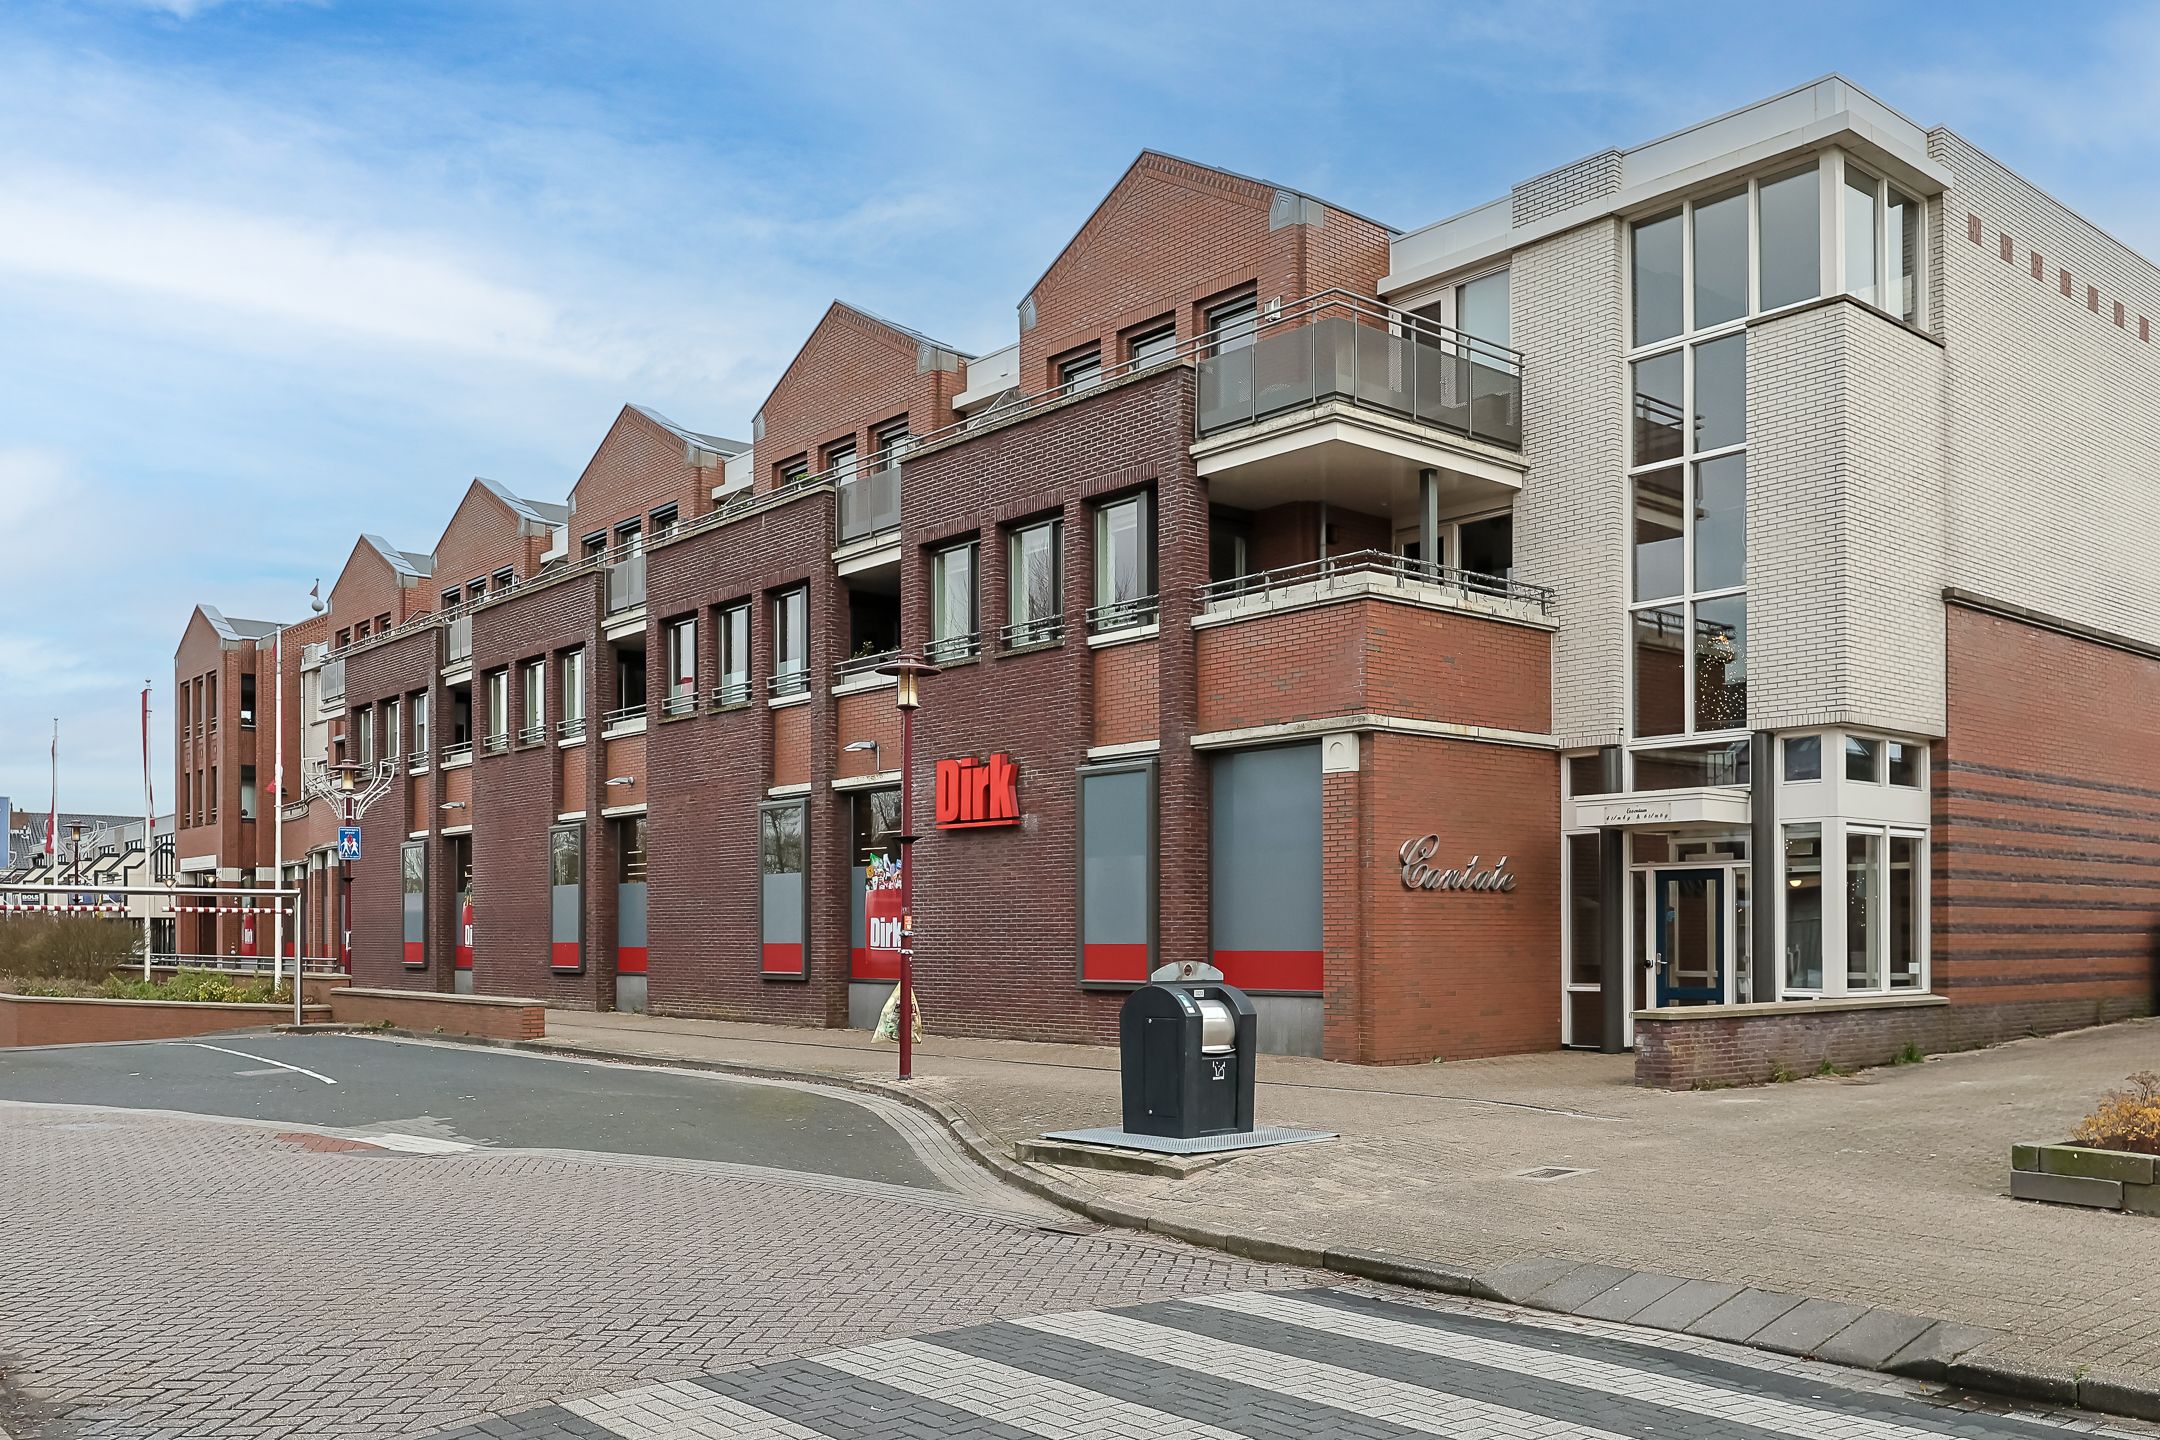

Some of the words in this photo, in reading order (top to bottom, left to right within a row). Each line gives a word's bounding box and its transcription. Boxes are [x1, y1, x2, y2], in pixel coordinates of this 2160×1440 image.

[936, 754, 1019, 825] Dirk
[1398, 833, 1517, 892] Cantate
[870, 916, 902, 948] Dirk
